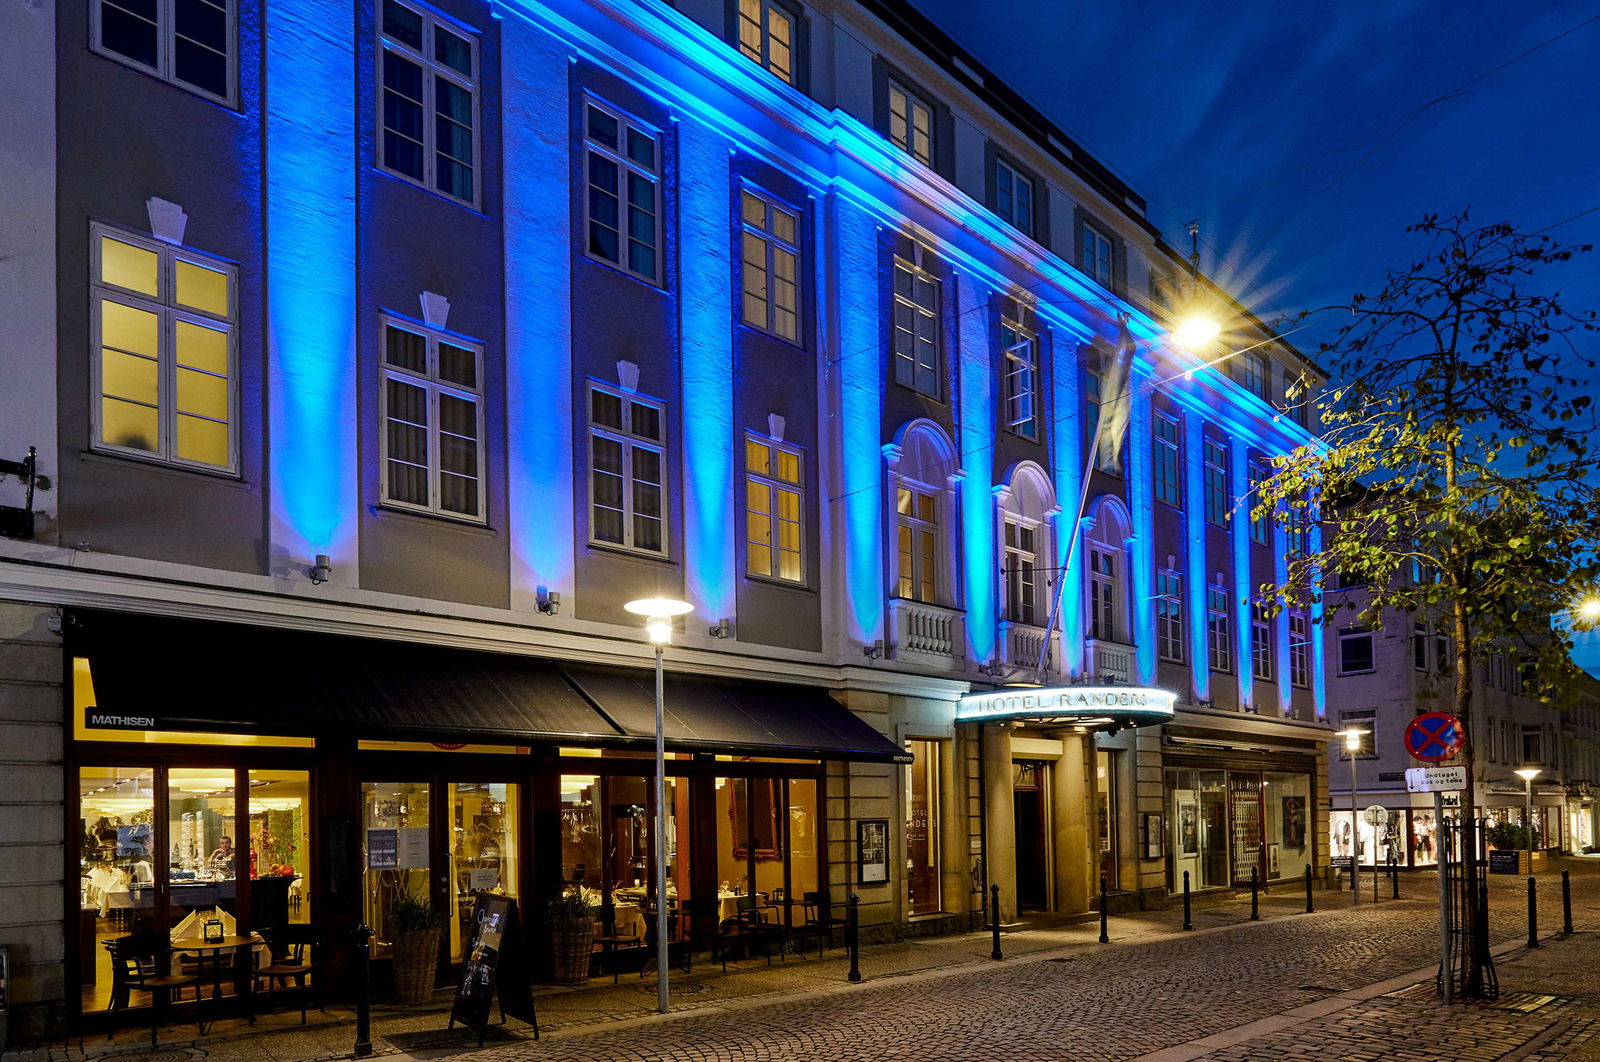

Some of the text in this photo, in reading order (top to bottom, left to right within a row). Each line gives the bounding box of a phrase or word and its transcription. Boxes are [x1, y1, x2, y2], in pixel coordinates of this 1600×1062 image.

[978, 692, 1148, 712] HOTEL RANDERS
[91, 714, 155, 727] MATHISEN
[1424, 771, 1459, 779] Undtaget
